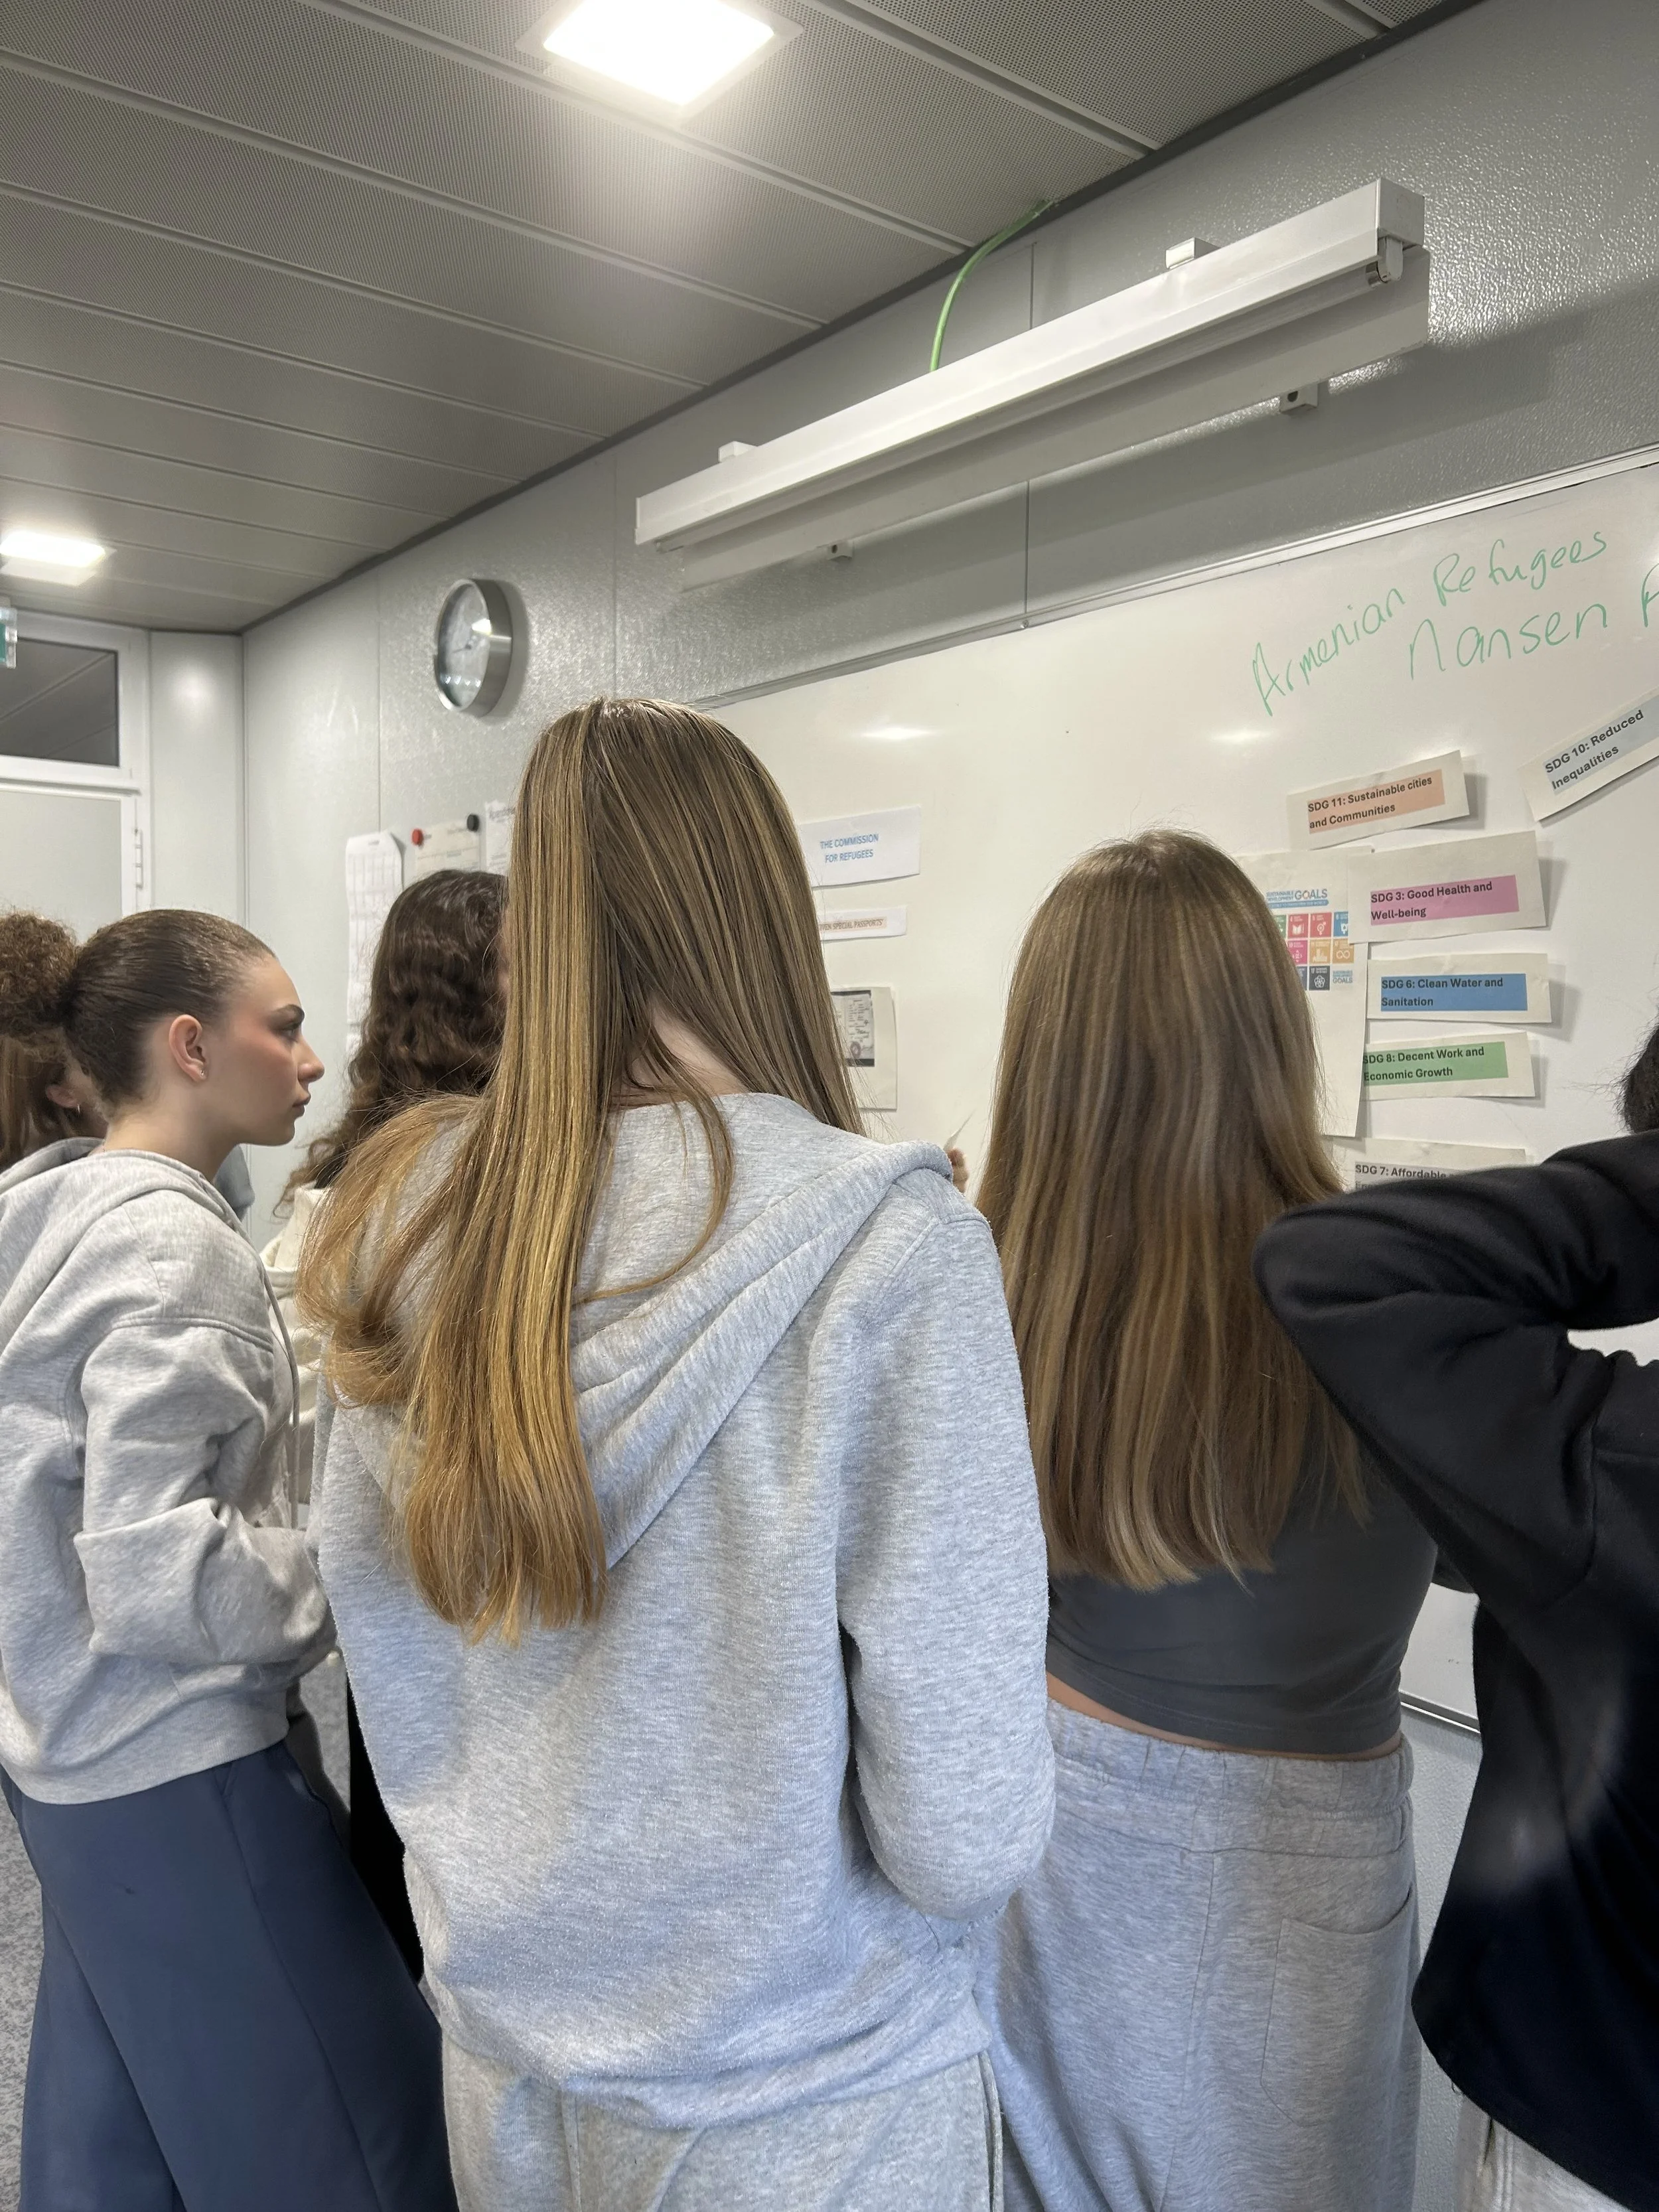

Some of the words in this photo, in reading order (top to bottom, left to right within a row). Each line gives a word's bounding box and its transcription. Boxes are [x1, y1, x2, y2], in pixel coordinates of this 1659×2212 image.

[1253, 588, 1406, 717] Armenian
[1433, 531, 1608, 607] Refugees
[1545, 753, 1571, 773] SDG
[1571, 743, 1590, 757] 10:
[1590, 709, 1644, 747] Reduced
[1551, 746, 1619, 790] Inequalities
[1308, 800, 1329, 812] SDG
[1331, 798, 1346, 808] 11:
[1348, 783, 1406, 804] Sustainable
[1407, 776, 1433, 790] cities
[1309, 818, 1327, 829] and
[1329, 804, 1396, 825] Communities
[820, 840, 833, 849] THE
[834, 834, 879, 848] COMMISSION
[825, 853, 838, 863] FOR
[839, 849, 873, 861] REFUGEES
[1294, 889, 1328, 901] GOALS
[1371, 892, 1394, 903] SDG
[1396, 891, 1405, 901] 3:
[1407, 888, 1434, 899] Good
[1437, 884, 1471, 896] Health
[1473, 881, 1492, 891] and
[1370, 907, 1427, 921] Well-being
[1381, 980, 1404, 989] SDG
[1406, 980, 1415, 989] 6:
[1417, 979, 1448, 988] Clean
[1451, 978, 1482, 988] Water
[1484, 977, 1504, 987] and
[1381, 996, 1434, 1007] Sanitation
[1362, 1054, 1384, 1064] SDG
[1386, 1053, 1396, 1063] 8:
[1398, 1051, 1434, 1062] Decent
[1436, 1048, 1463, 1059] Work
[1465, 1046, 1485, 1057] and
[1363, 1070, 1413, 1081] Economic
[1415, 1067, 1453, 1078] Growth
[1355, 1164, 1378, 1175] SDG
[1380, 1166, 1389, 1176] 7:
